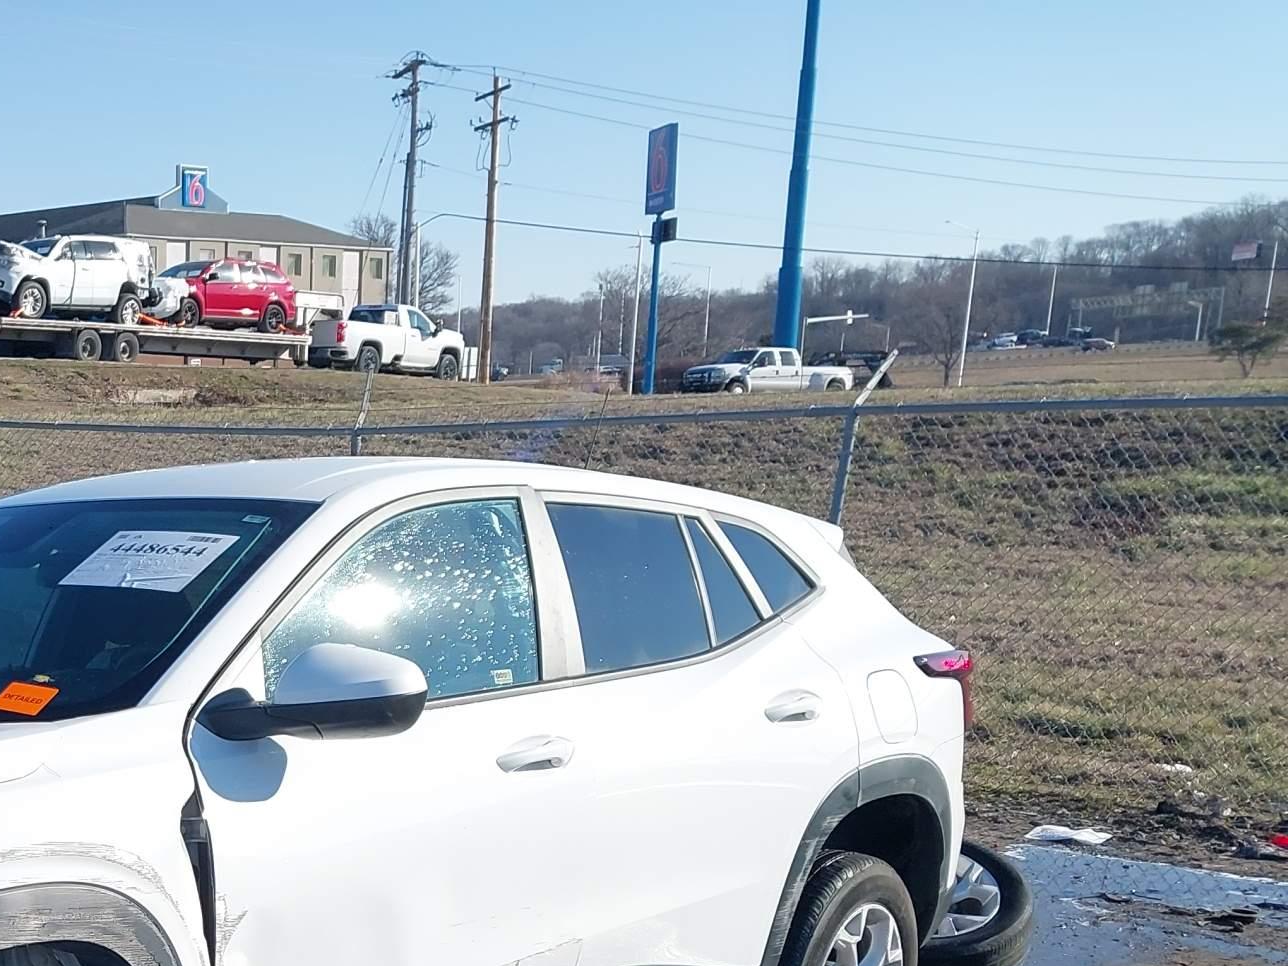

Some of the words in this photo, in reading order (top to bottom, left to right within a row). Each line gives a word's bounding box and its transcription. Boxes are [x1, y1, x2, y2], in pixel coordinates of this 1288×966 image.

[650, 130, 669, 193] 6
[189, 173, 205, 207] 6
[109, 542, 209, 558] 44486544
